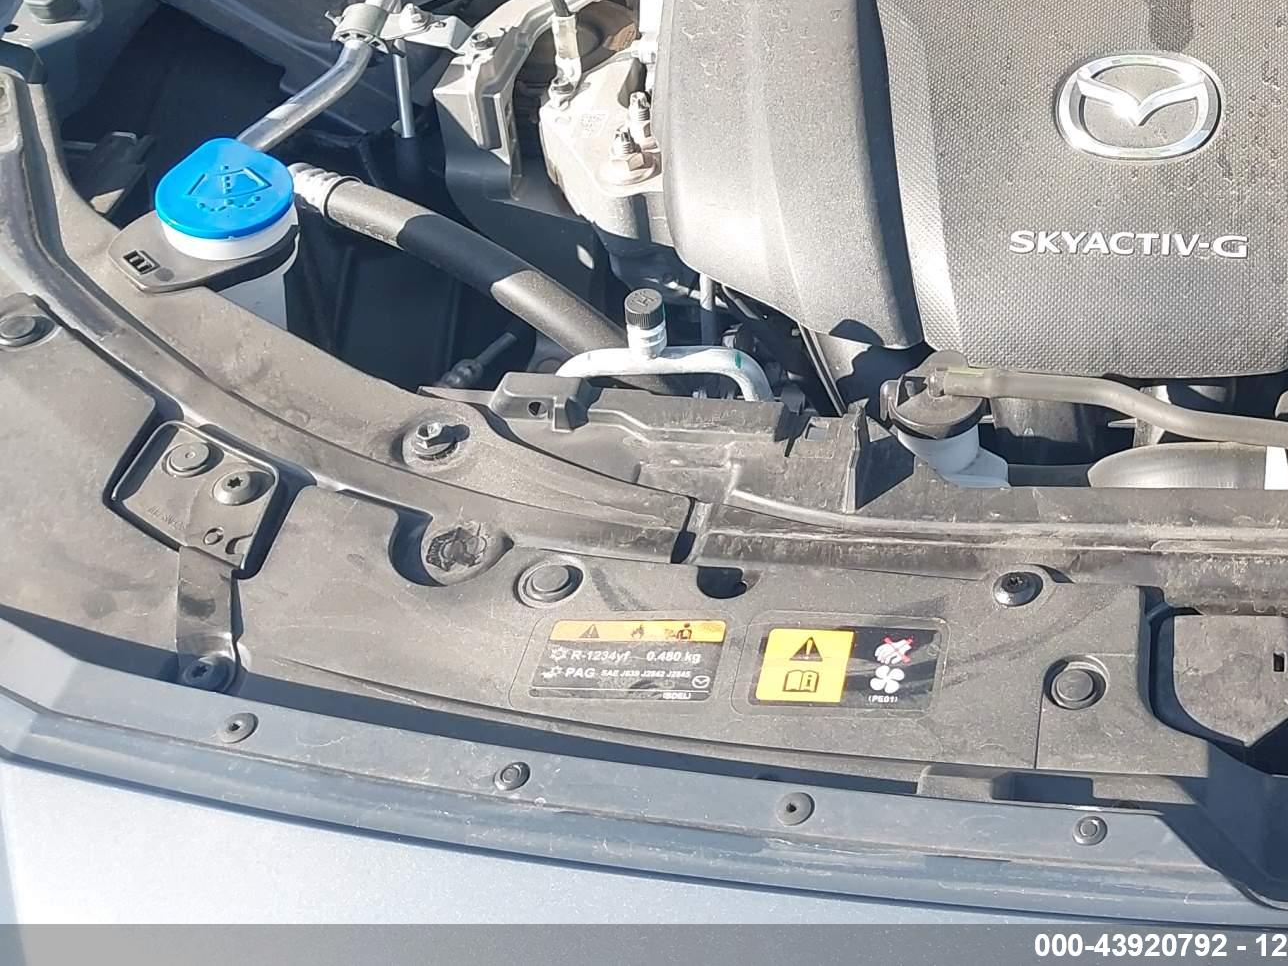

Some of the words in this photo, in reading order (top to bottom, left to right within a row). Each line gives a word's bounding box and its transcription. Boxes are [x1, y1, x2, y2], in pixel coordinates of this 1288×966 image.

[1008, 230, 1249, 259] SKYACTIV-G
[571, 650, 631, 663] R-1234yf
[646, 651, 682, 662] 0.480
[684, 650, 702, 665] kg
[564, 667, 596, 679] PAG
